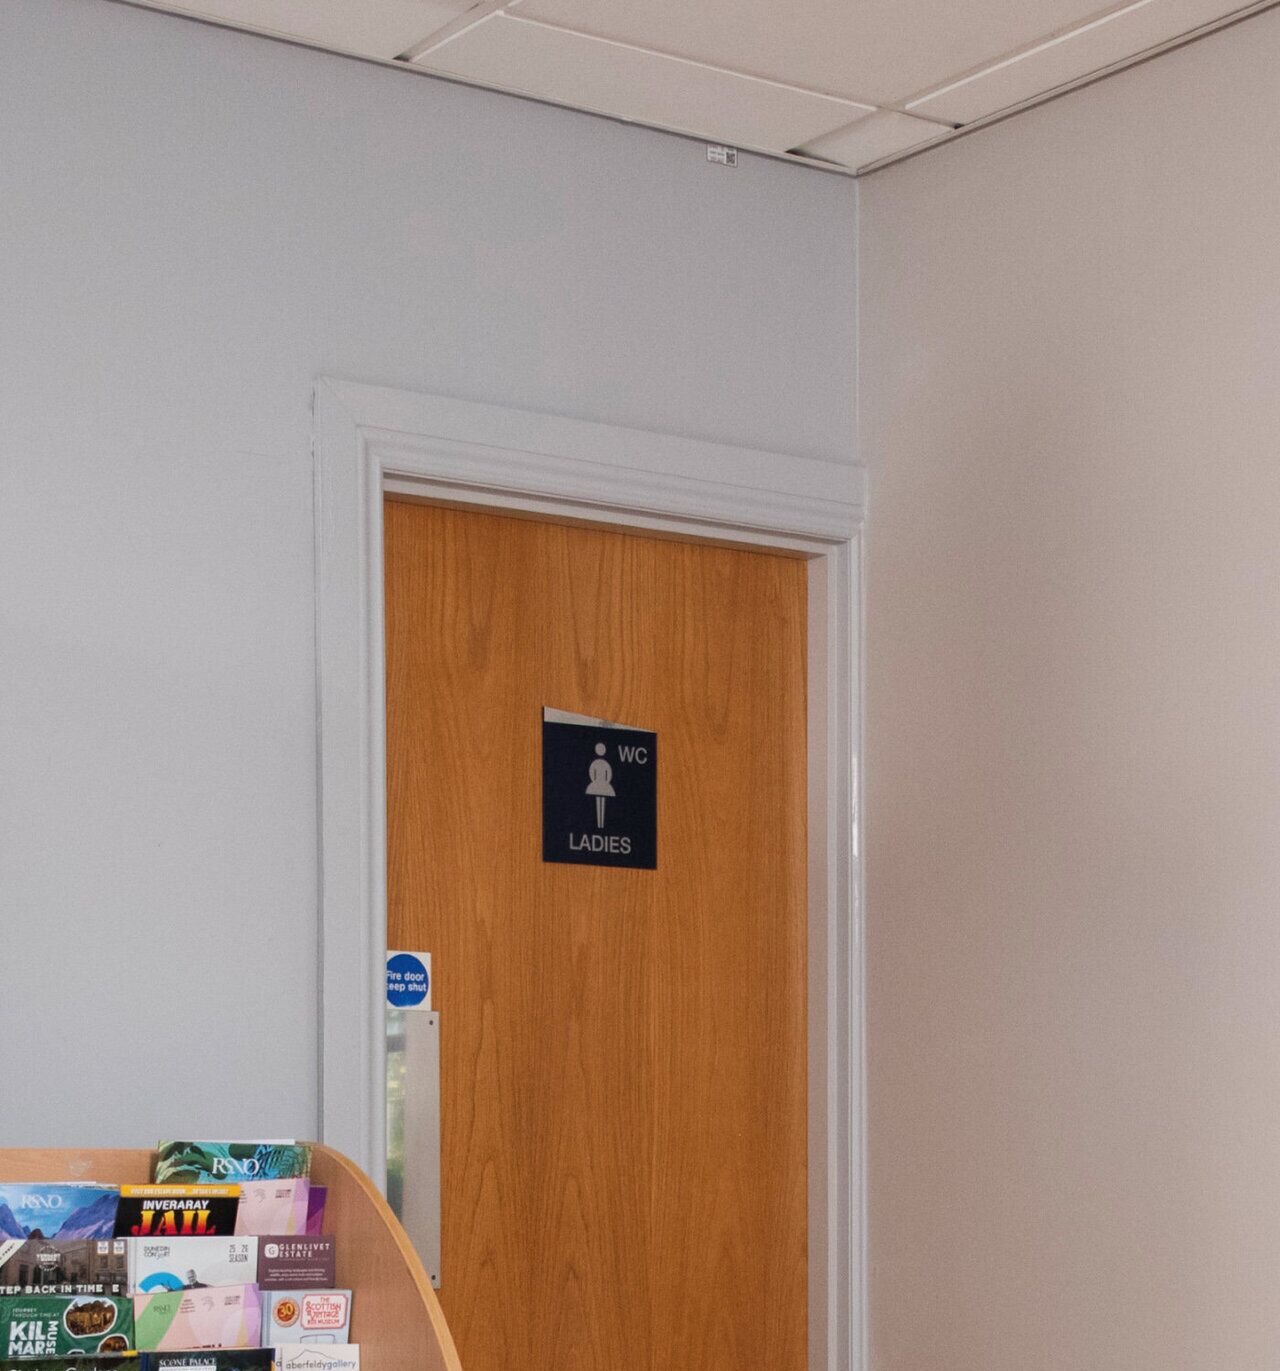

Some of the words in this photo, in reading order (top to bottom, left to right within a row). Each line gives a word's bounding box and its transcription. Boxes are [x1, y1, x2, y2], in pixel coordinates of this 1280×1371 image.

[618, 745, 648, 765] WC
[569, 832, 632, 854] LADIES
[404, 971, 425, 982] door
[388, 983, 406, 993] eep
[407, 982, 427, 992] shut
[212, 1157, 260, 1175] RSNO
[143, 1199, 210, 1210] INVERARAY
[130, 1210, 216, 1236] JAIL
[279, 1243, 331, 1251] GLENLIVET
[229, 1253, 249, 1262] SEASON
[279, 1250, 312, 1258] ESTATE
[25, 1284, 56, 1294] BACK
[60, 1284, 72, 1293] IN
[75, 1284, 104, 1292] TIME
[305, 1301, 342, 1312] SCOTTISH
[8, 1340, 46, 1355] MAR
[159, 1358, 188, 1367] SCONE
[189, 1357, 217, 1366] PALACE
[286, 1360, 357, 1370] aberfeldygallery
